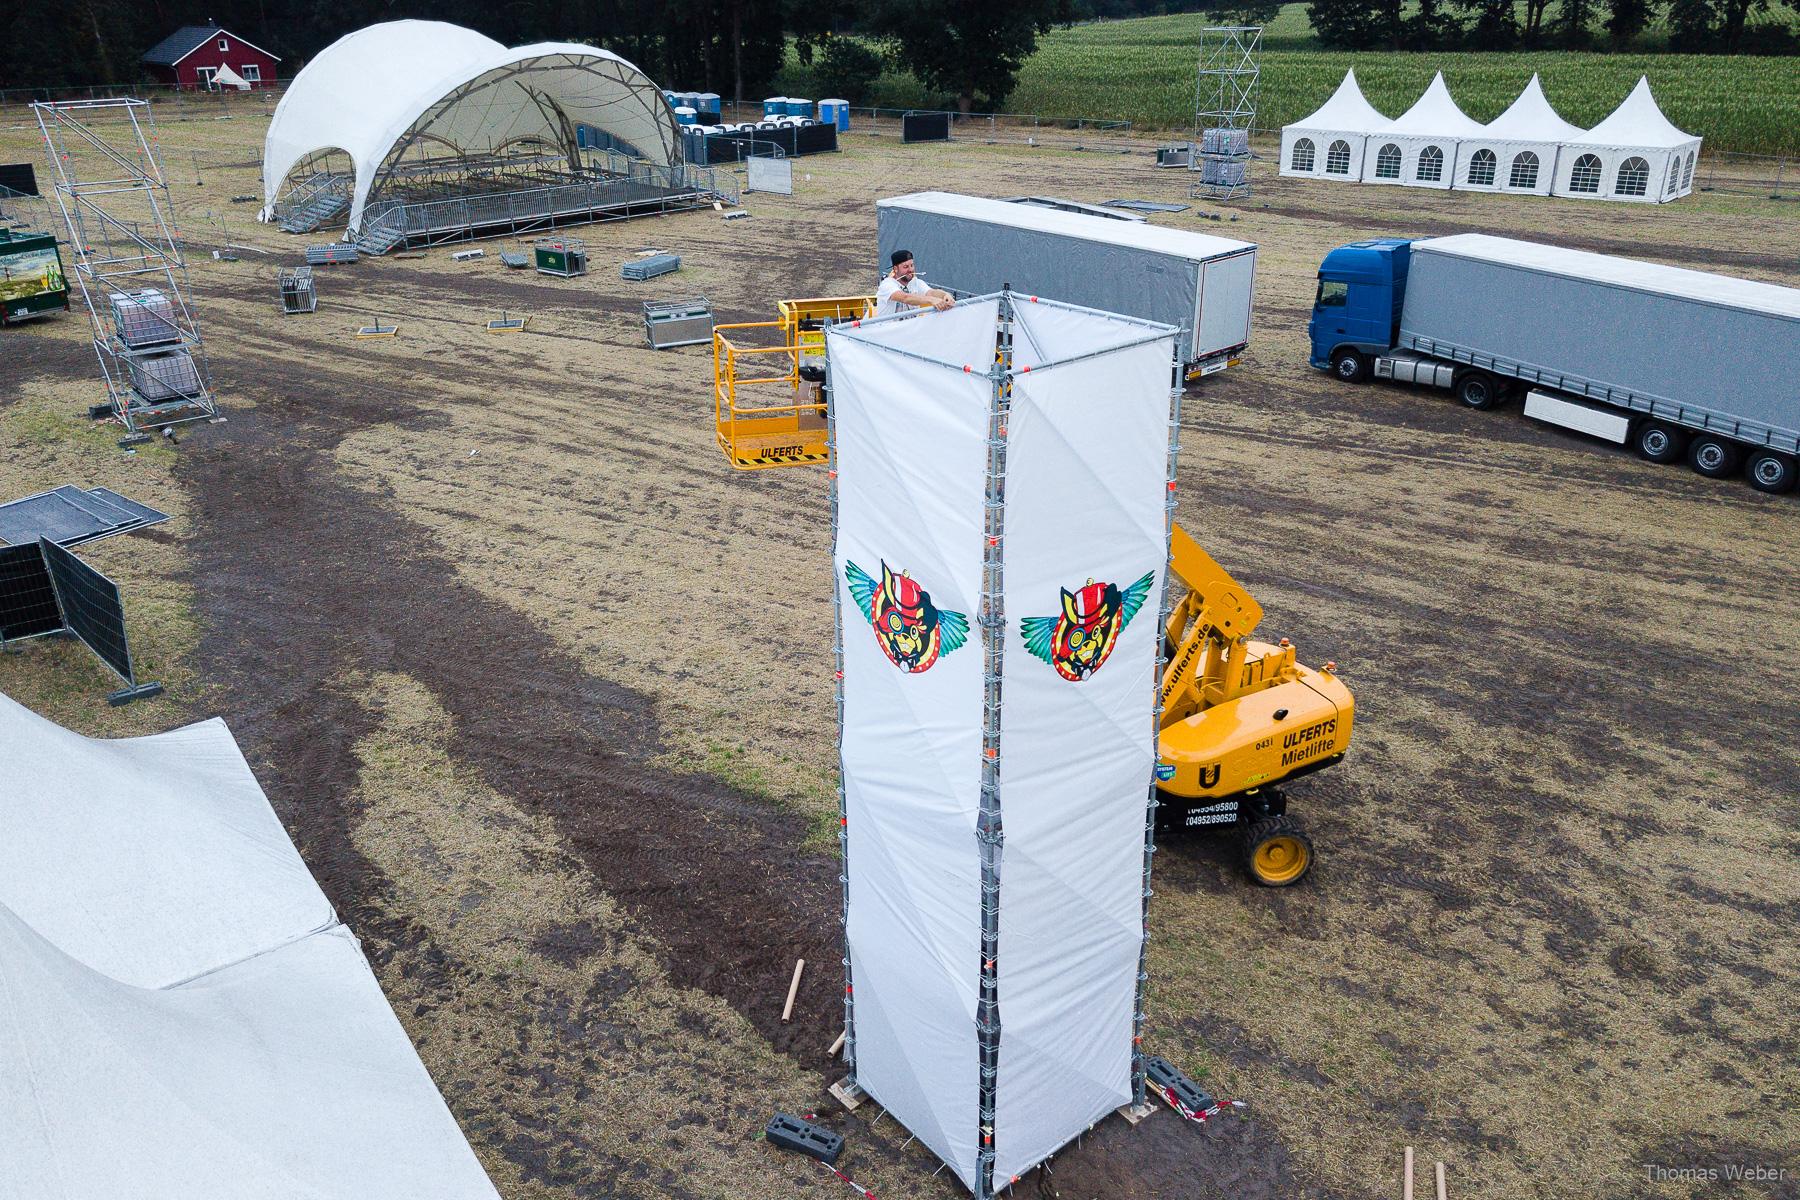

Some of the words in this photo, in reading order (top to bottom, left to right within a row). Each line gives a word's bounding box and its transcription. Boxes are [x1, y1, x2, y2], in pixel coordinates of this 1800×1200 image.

[761, 445, 803, 458] ULFERTS
[1283, 718, 1336, 749] ULFERTS
[1281, 739, 1334, 767] Mietlifte
